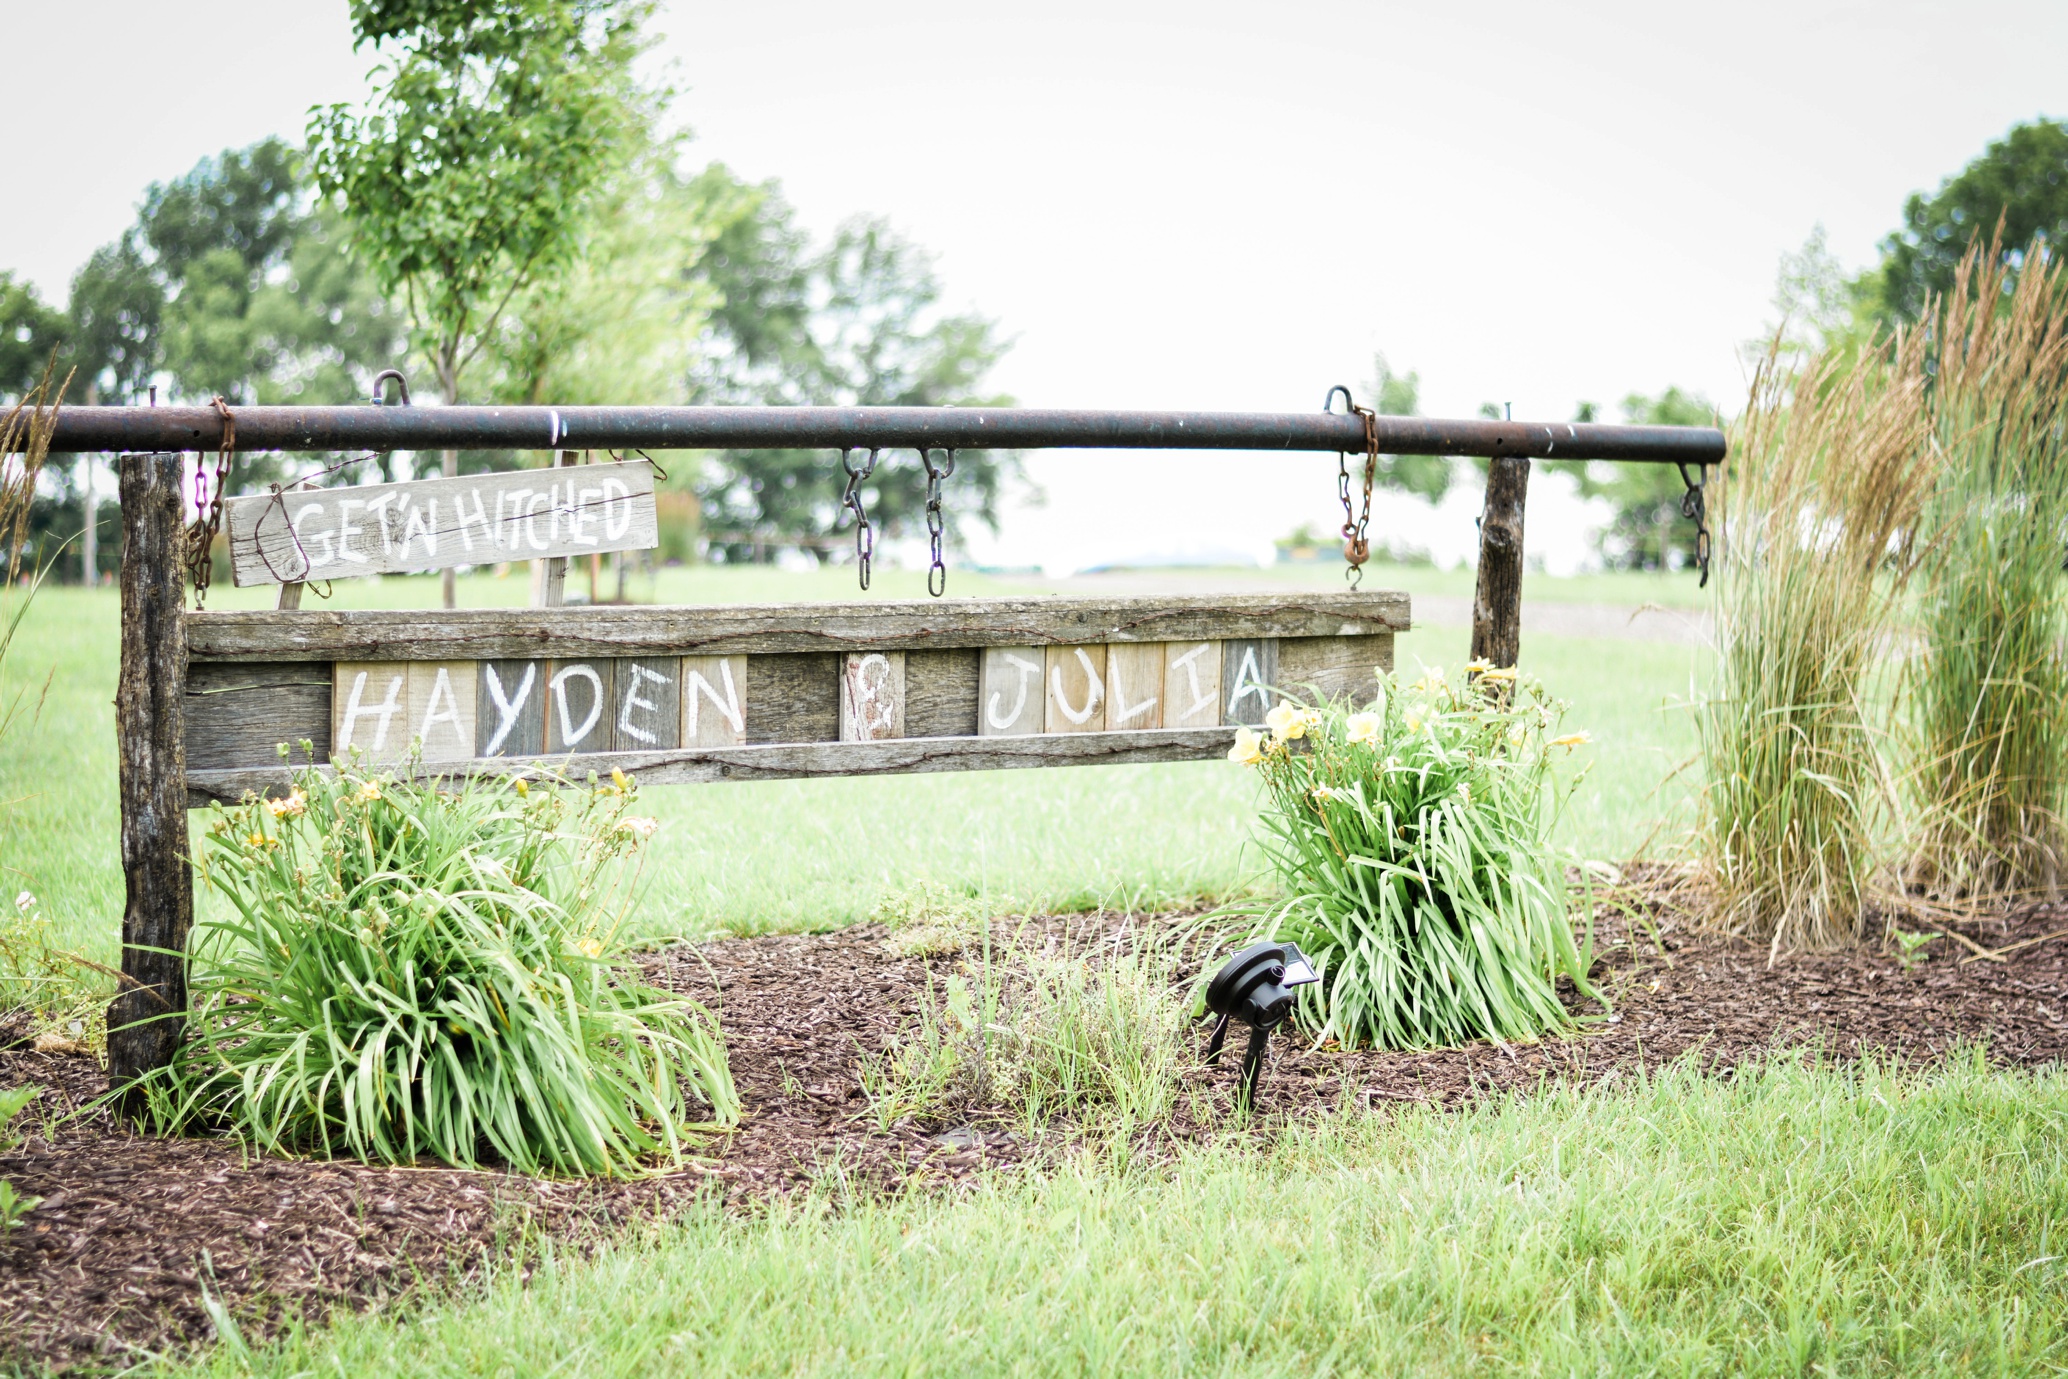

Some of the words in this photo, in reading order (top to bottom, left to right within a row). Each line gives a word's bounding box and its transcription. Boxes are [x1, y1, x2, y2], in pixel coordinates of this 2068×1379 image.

[293, 491, 438, 566] GET'N
[454, 477, 631, 551] HITCHED
[339, 658, 745, 756] HAYDEN
[987, 645, 1270, 729] JULIA
